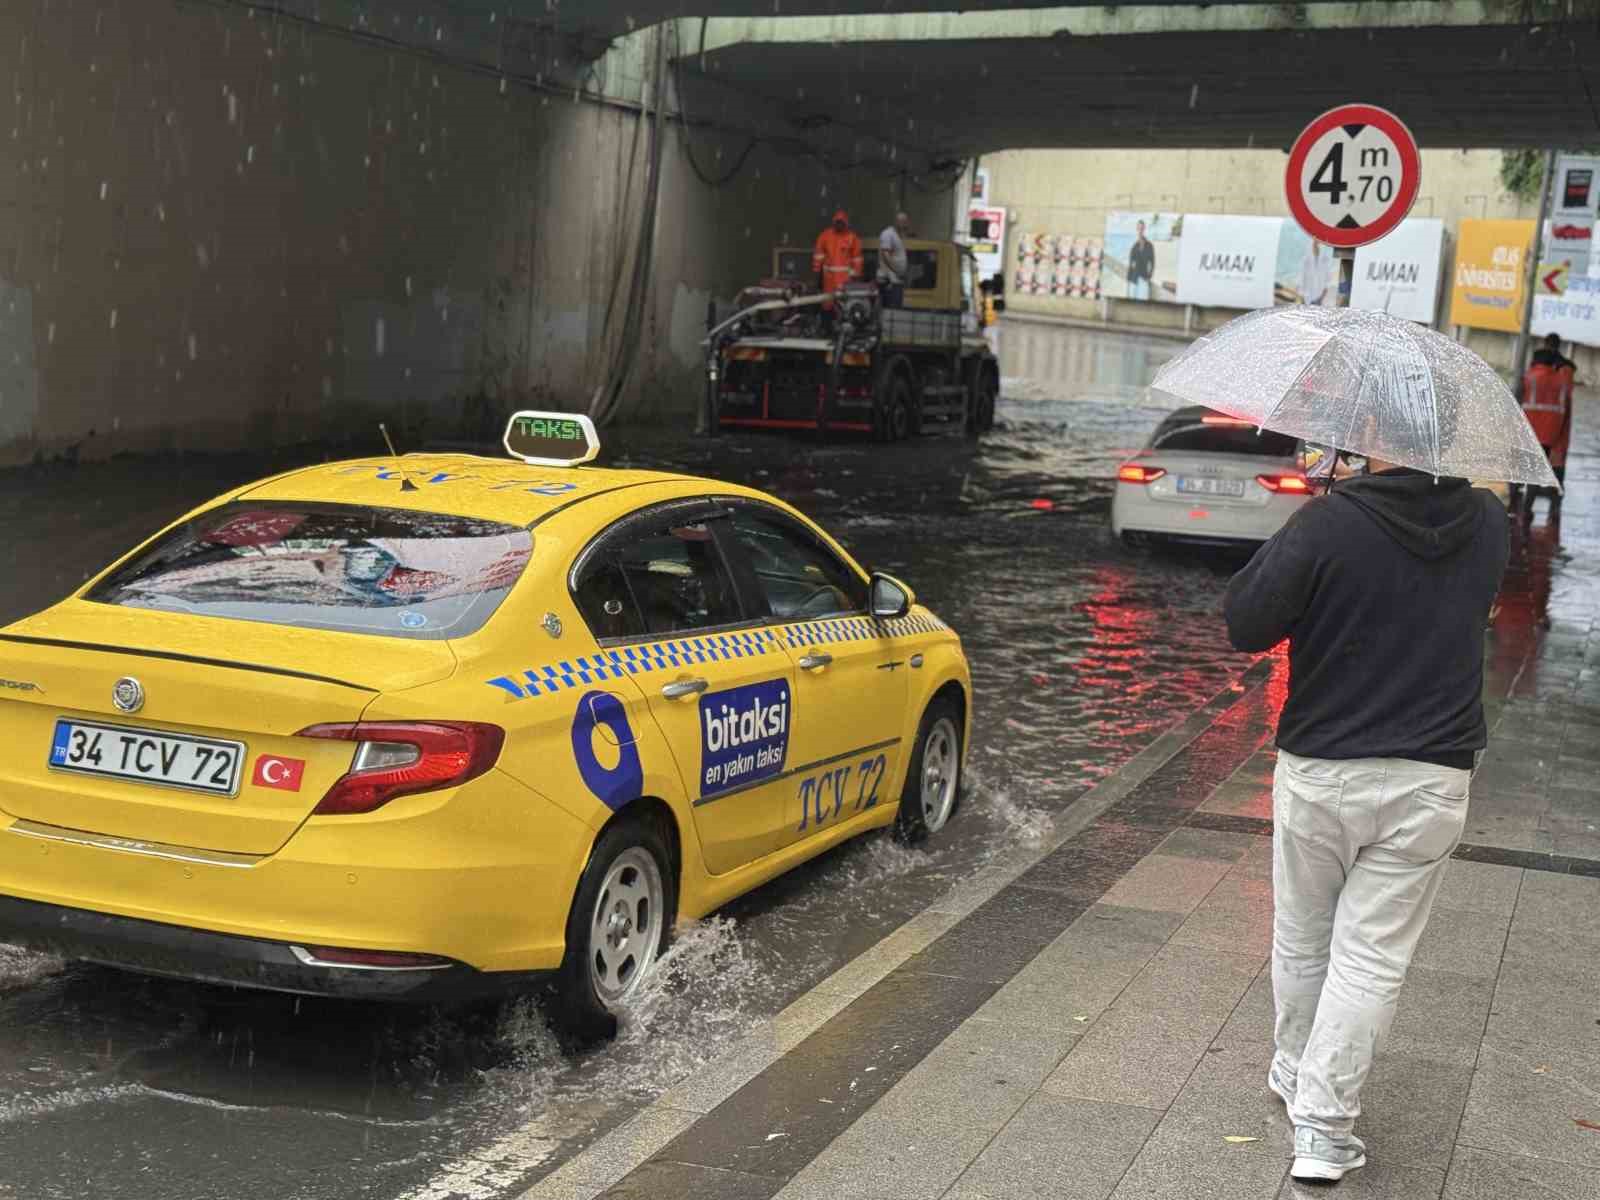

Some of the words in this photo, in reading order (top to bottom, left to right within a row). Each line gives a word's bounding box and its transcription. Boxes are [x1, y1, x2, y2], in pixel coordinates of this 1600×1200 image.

[1360, 147, 1389, 167] m
[705, 690, 787, 752] bitaksi
[55, 746, 66, 756] TR
[69, 729, 103, 766] 34
[120, 735, 181, 776] TCV
[191, 746, 232, 785] 72
[705, 765, 720, 785] en
[722, 751, 754, 785] yakın
[756, 740, 785, 768] taksi
[797, 765, 852, 832] TCV
[854, 753, 887, 811] 72
